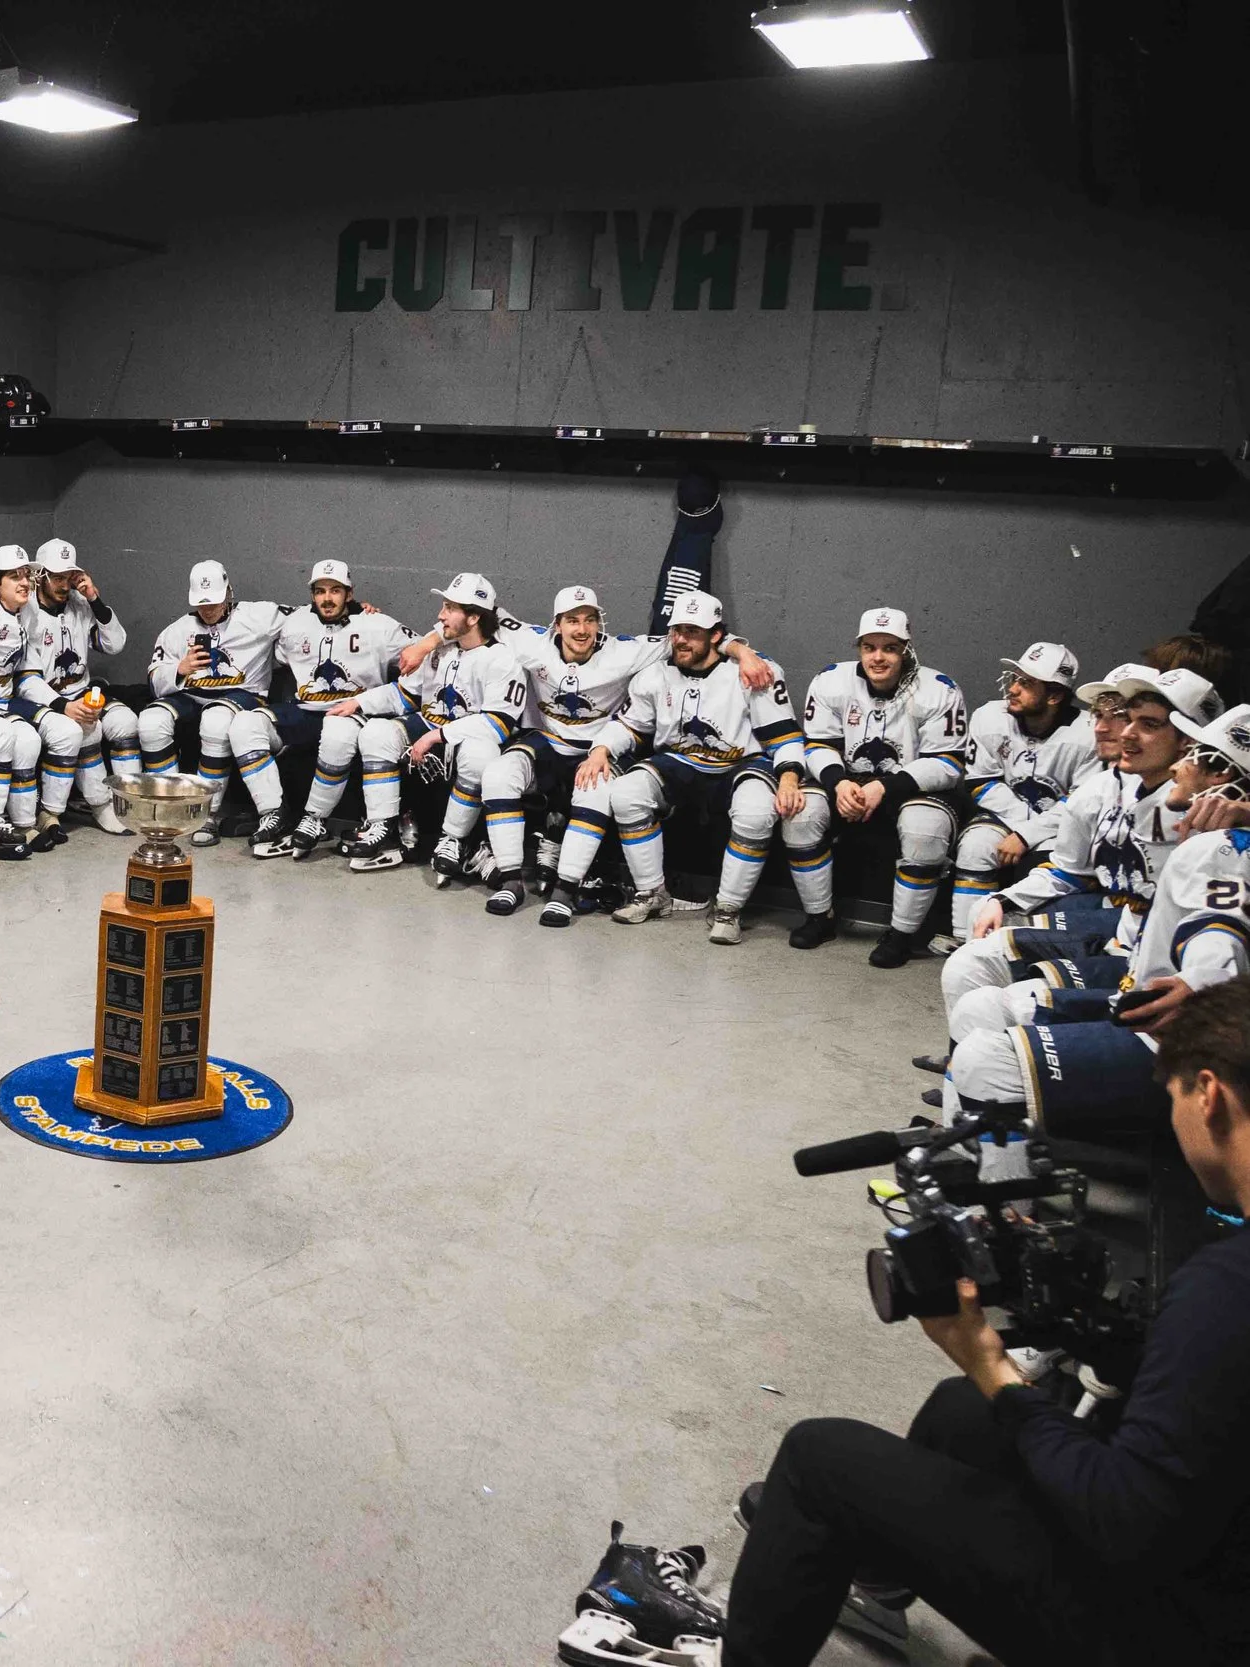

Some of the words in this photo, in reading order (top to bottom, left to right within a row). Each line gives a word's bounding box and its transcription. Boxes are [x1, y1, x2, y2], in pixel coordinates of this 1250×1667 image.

[805, 434, 816, 443] 25
[1102, 446, 1113, 456] 15
[499, 617, 523, 631] 8
[349, 633, 360, 653] C
[504, 679, 526, 707] 10
[943, 709, 967, 737] 15
[1151, 806, 1167, 842] A
[1206, 879, 1250, 910] 2
[1059, 957, 1087, 990] BAUE
[1035, 1024, 1064, 1082] BAUER
[13, 1094, 205, 1153] STAMPEDE
